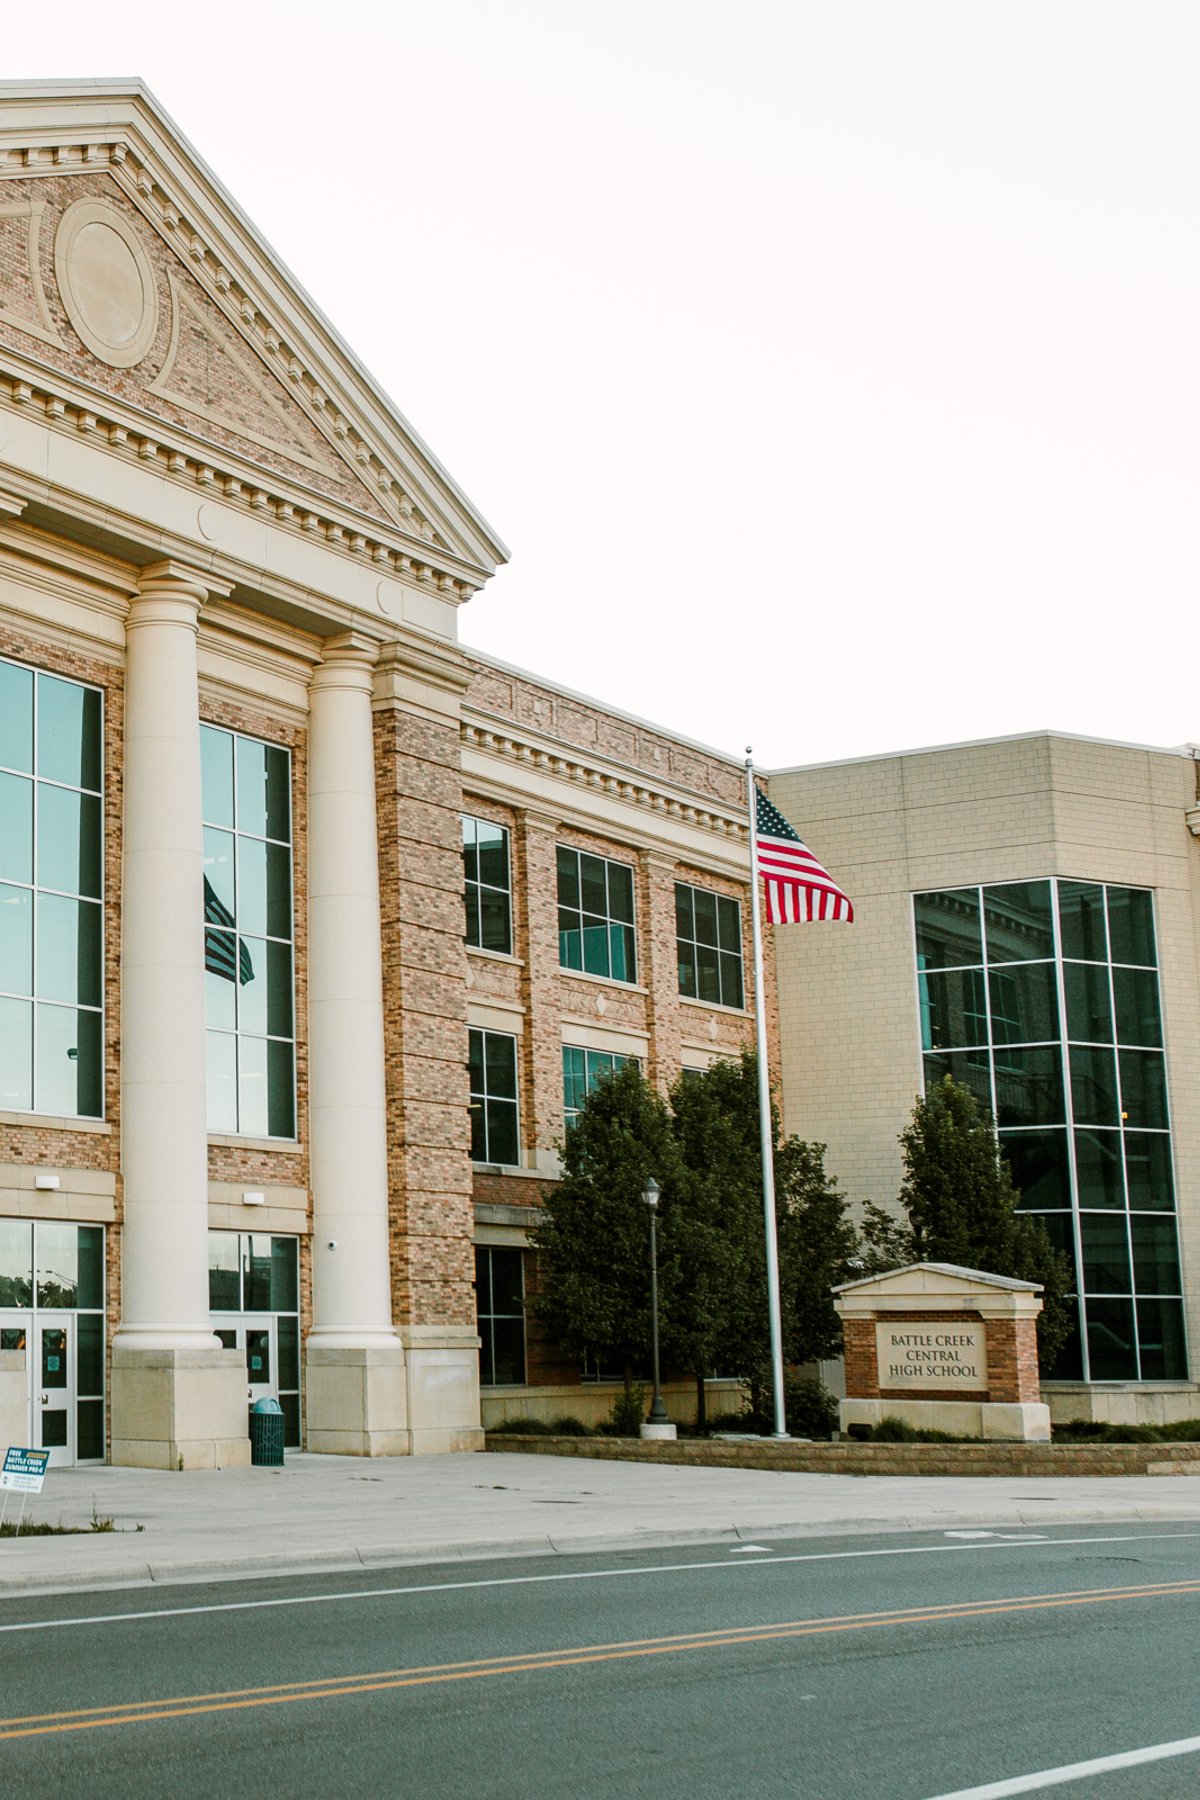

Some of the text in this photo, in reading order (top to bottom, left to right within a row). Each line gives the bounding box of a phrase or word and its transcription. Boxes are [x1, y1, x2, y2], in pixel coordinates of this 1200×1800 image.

[891, 1335, 975, 1347] BATTLE CREEK
[906, 1350, 961, 1361] CENTRAL
[890, 1365, 978, 1377] HIGH SCHOOL
[7, 1457, 26, 1465] BATTLE
